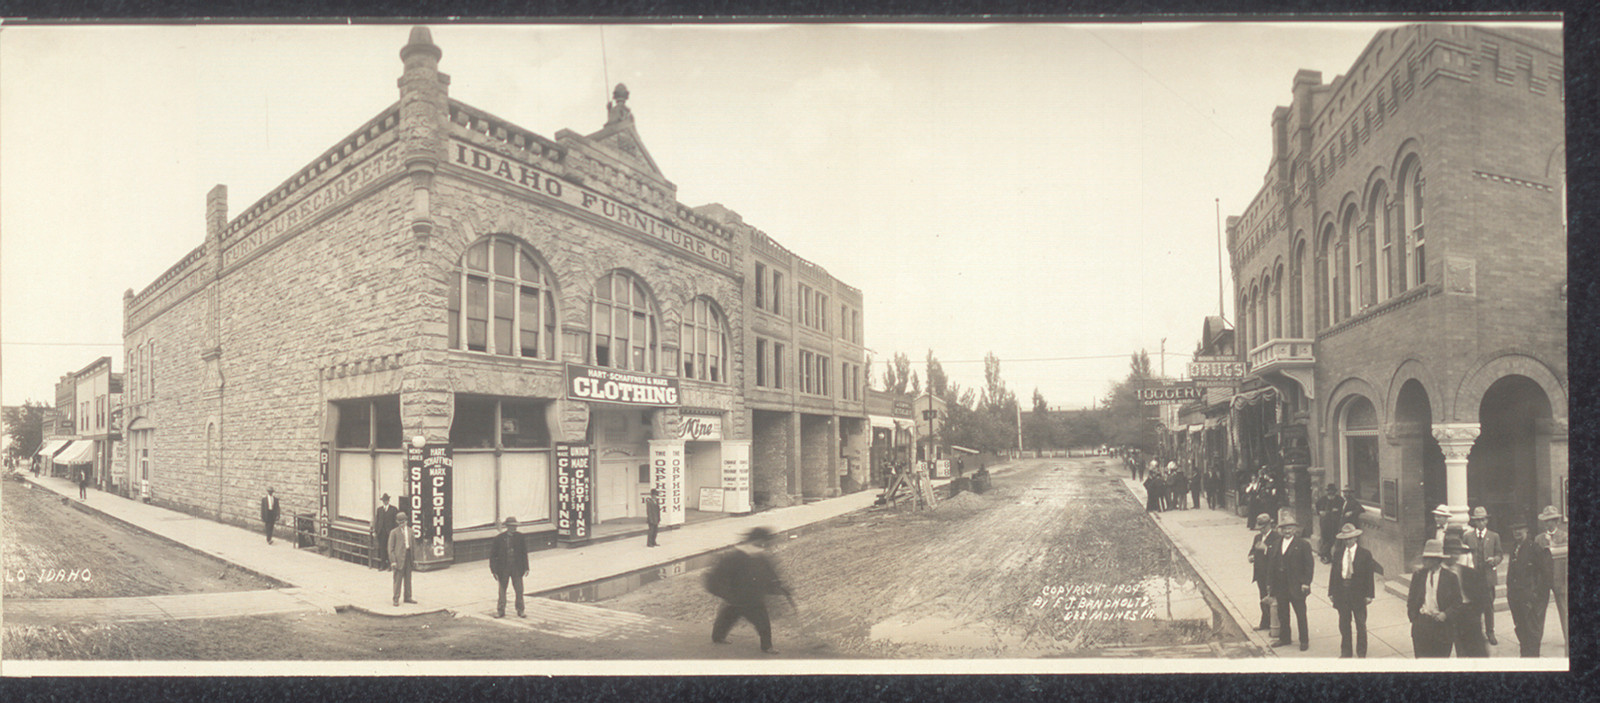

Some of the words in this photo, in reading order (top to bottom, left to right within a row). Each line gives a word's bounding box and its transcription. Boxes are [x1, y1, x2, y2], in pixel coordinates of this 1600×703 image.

[225, 203, 312, 265] FURNITURE
[313, 149, 399, 211] CARPETS
[456, 144, 563, 198] IDAHO
[581, 191, 706, 256] FURNITURE
[573, 377, 678, 404] CLOTHING
[1191, 363, 1243, 377] DRUGS
[429, 467, 447, 476] MARX
[558, 458, 570, 528] CLOTHING
[571, 458, 589, 469] MADE
[672, 459, 681, 513] ORPHEUM
[411, 466, 422, 539] SHOES
[432, 476, 445, 557] CLOTHING
[575, 469, 586, 537] CLOTHING
